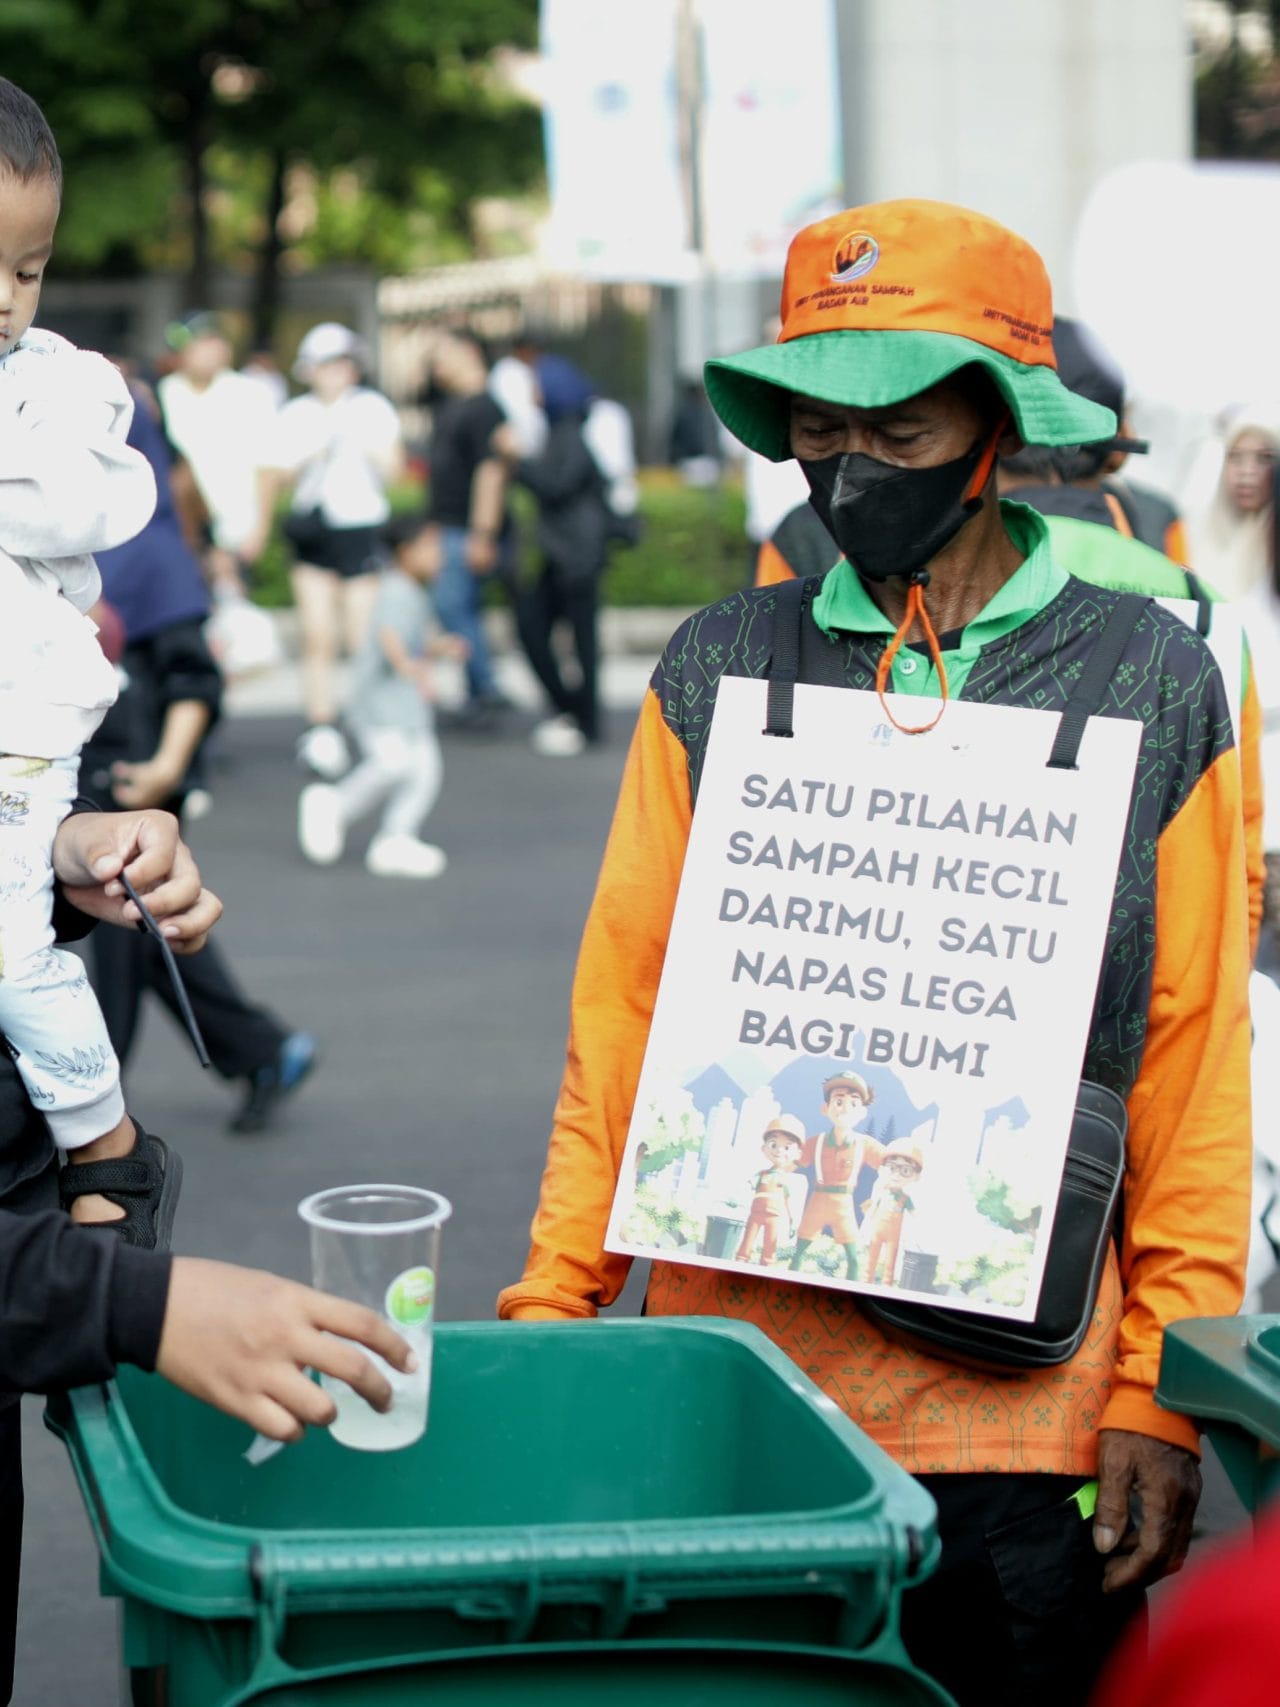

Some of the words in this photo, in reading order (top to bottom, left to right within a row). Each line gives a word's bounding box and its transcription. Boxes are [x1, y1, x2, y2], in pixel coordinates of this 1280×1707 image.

[871, 284, 915, 296] SAMPAH
[742, 775, 854, 817] SATU
[867, 789, 1076, 844] PILAHAN
[727, 831, 918, 885] SAMPAH
[933, 857, 1067, 905] KECIL
[719, 888, 910, 949] DARIMU,
[940, 919, 1056, 963] SATU
[732, 950, 887, 1001] NAPAS
[901, 973, 1016, 1020] LEGA
[739, 1010, 854, 1057] BAGI
[867, 1028, 989, 1077] BUMI
